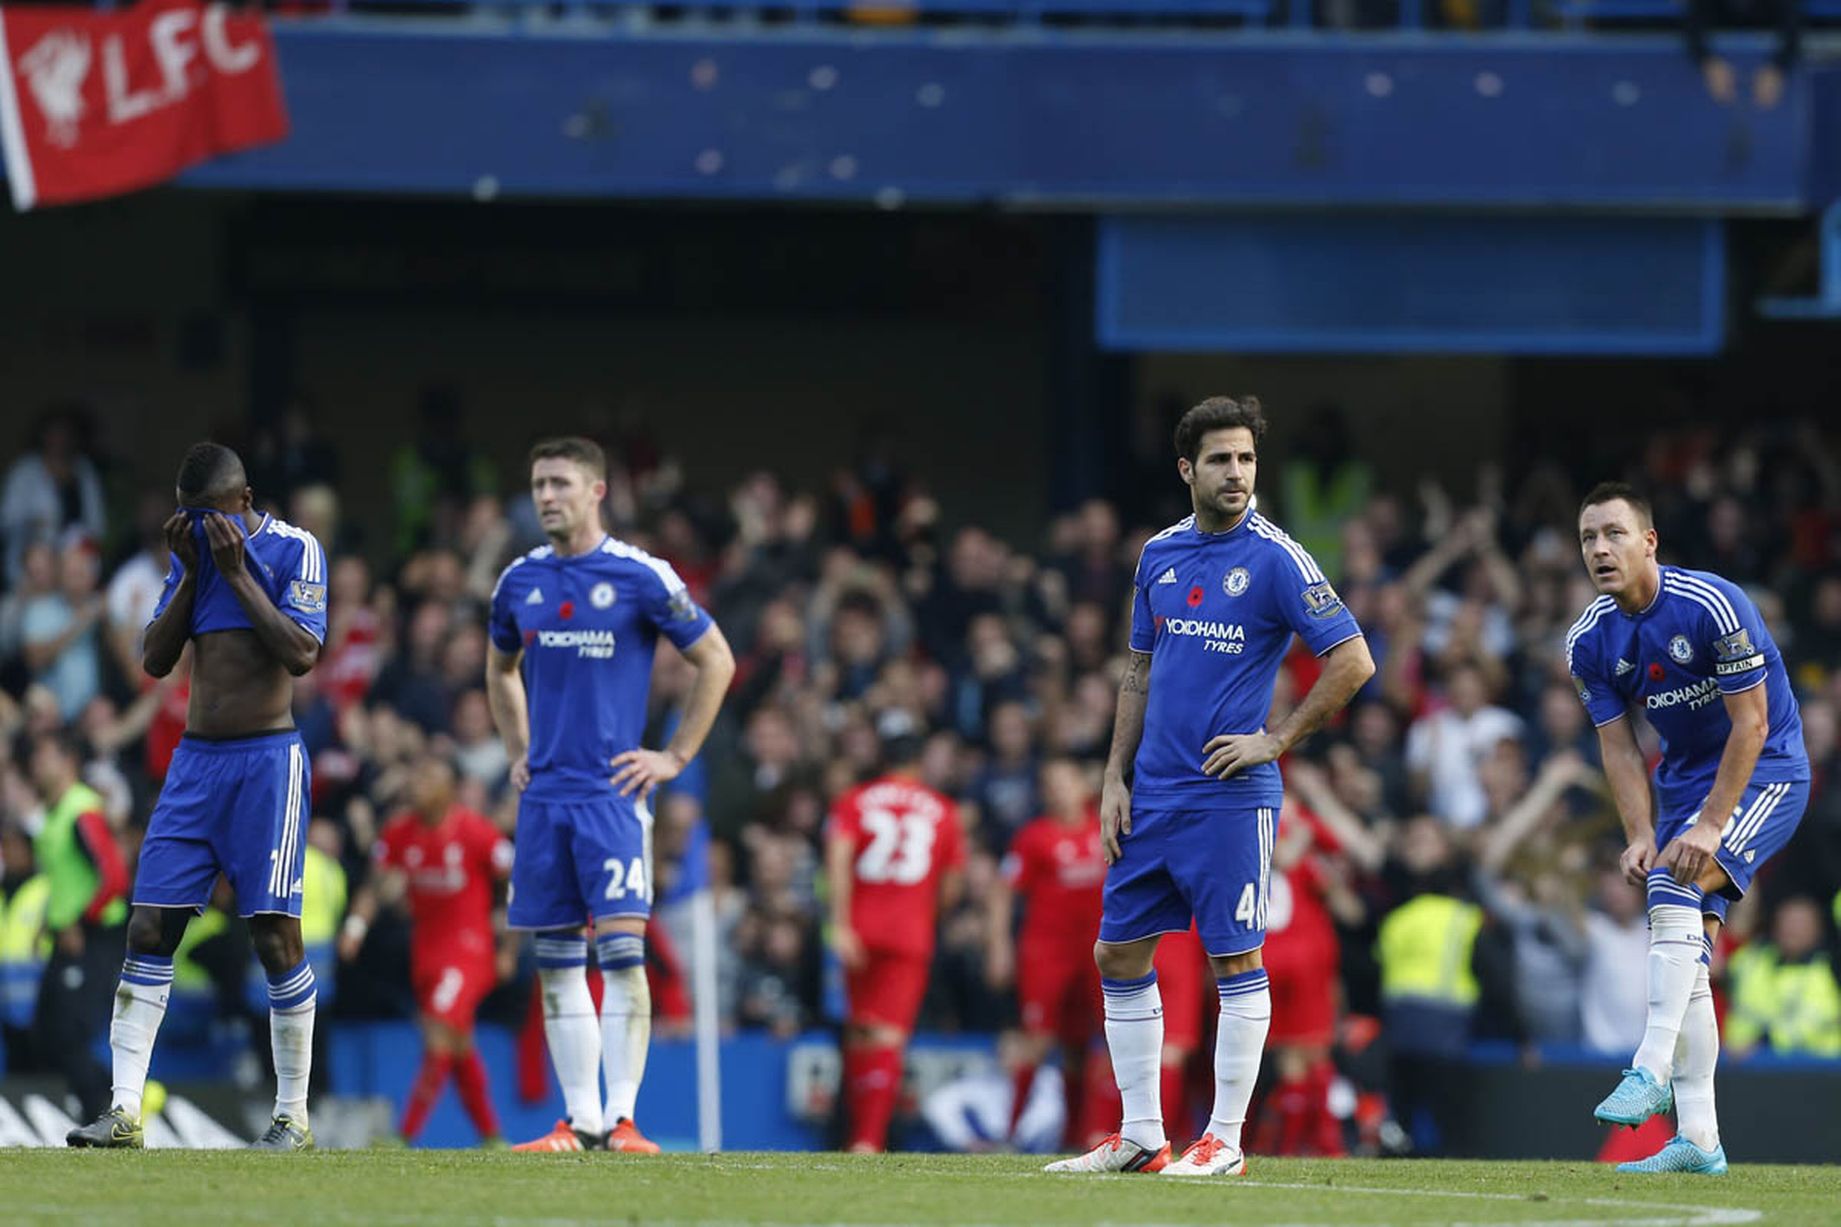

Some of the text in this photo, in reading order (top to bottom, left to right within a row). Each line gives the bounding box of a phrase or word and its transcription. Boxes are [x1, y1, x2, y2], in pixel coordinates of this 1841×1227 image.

[538, 629, 615, 647] YOKOHAMA
[1166, 618, 1245, 641] YOKOHAMA
[1203, 639, 1244, 654] TYRES
[1647, 676, 1719, 709] OKOHAMA
[856, 809, 937, 885] 23
[603, 857, 645, 900] 24
[1235, 882, 1255, 930] 4
